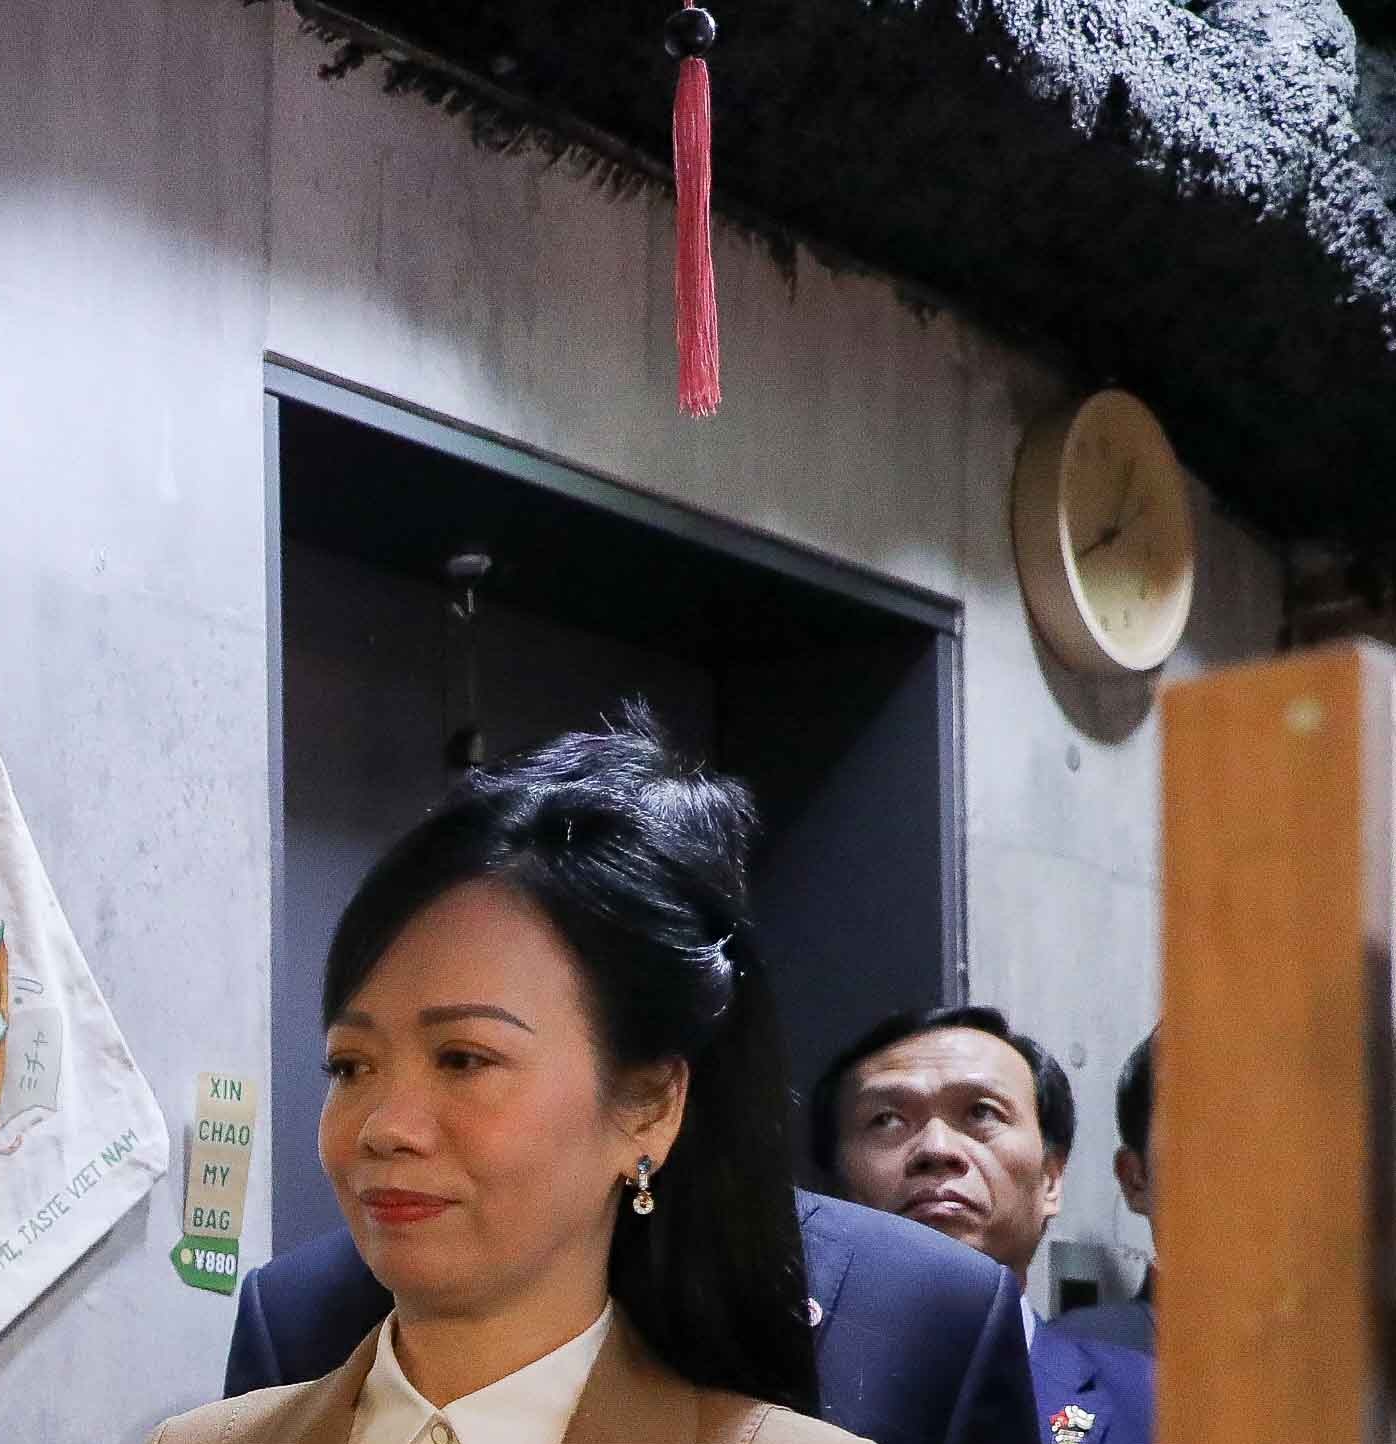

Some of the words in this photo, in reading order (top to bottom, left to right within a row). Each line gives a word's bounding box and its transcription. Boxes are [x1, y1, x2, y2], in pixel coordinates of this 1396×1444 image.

[210, 1079, 242, 1101] XIN
[18, 1193, 70, 1244] TASTE
[65, 1160, 102, 1199] VIET
[101, 1128, 139, 1168] NAM
[203, 1164, 230, 1187] MY
[192, 1207, 231, 1231] BAG
